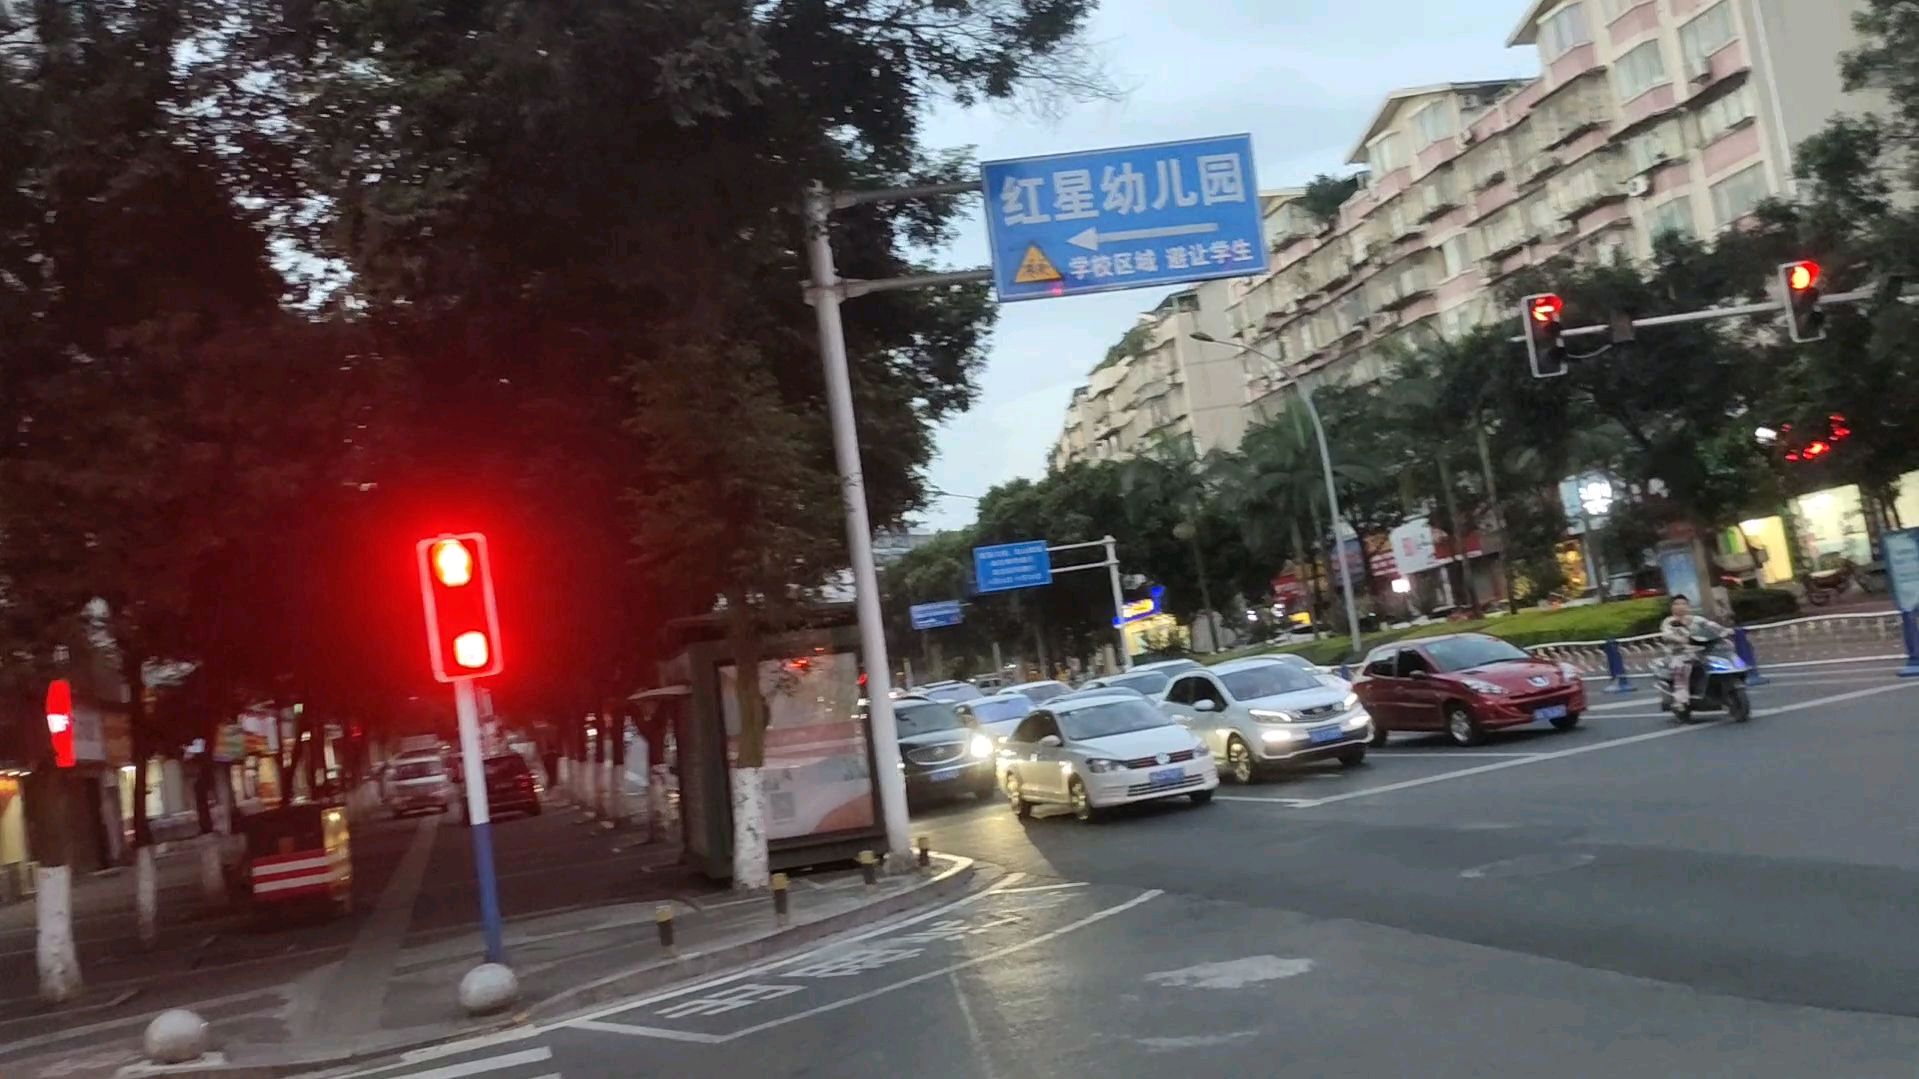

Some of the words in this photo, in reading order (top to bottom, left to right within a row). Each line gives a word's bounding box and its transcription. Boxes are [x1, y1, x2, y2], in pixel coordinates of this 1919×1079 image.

[1001, 153, 1246, 227] 红星幼儿园
[1069, 249, 1158, 280] 学校区域
[1165, 239, 1254, 269] 避让学生
